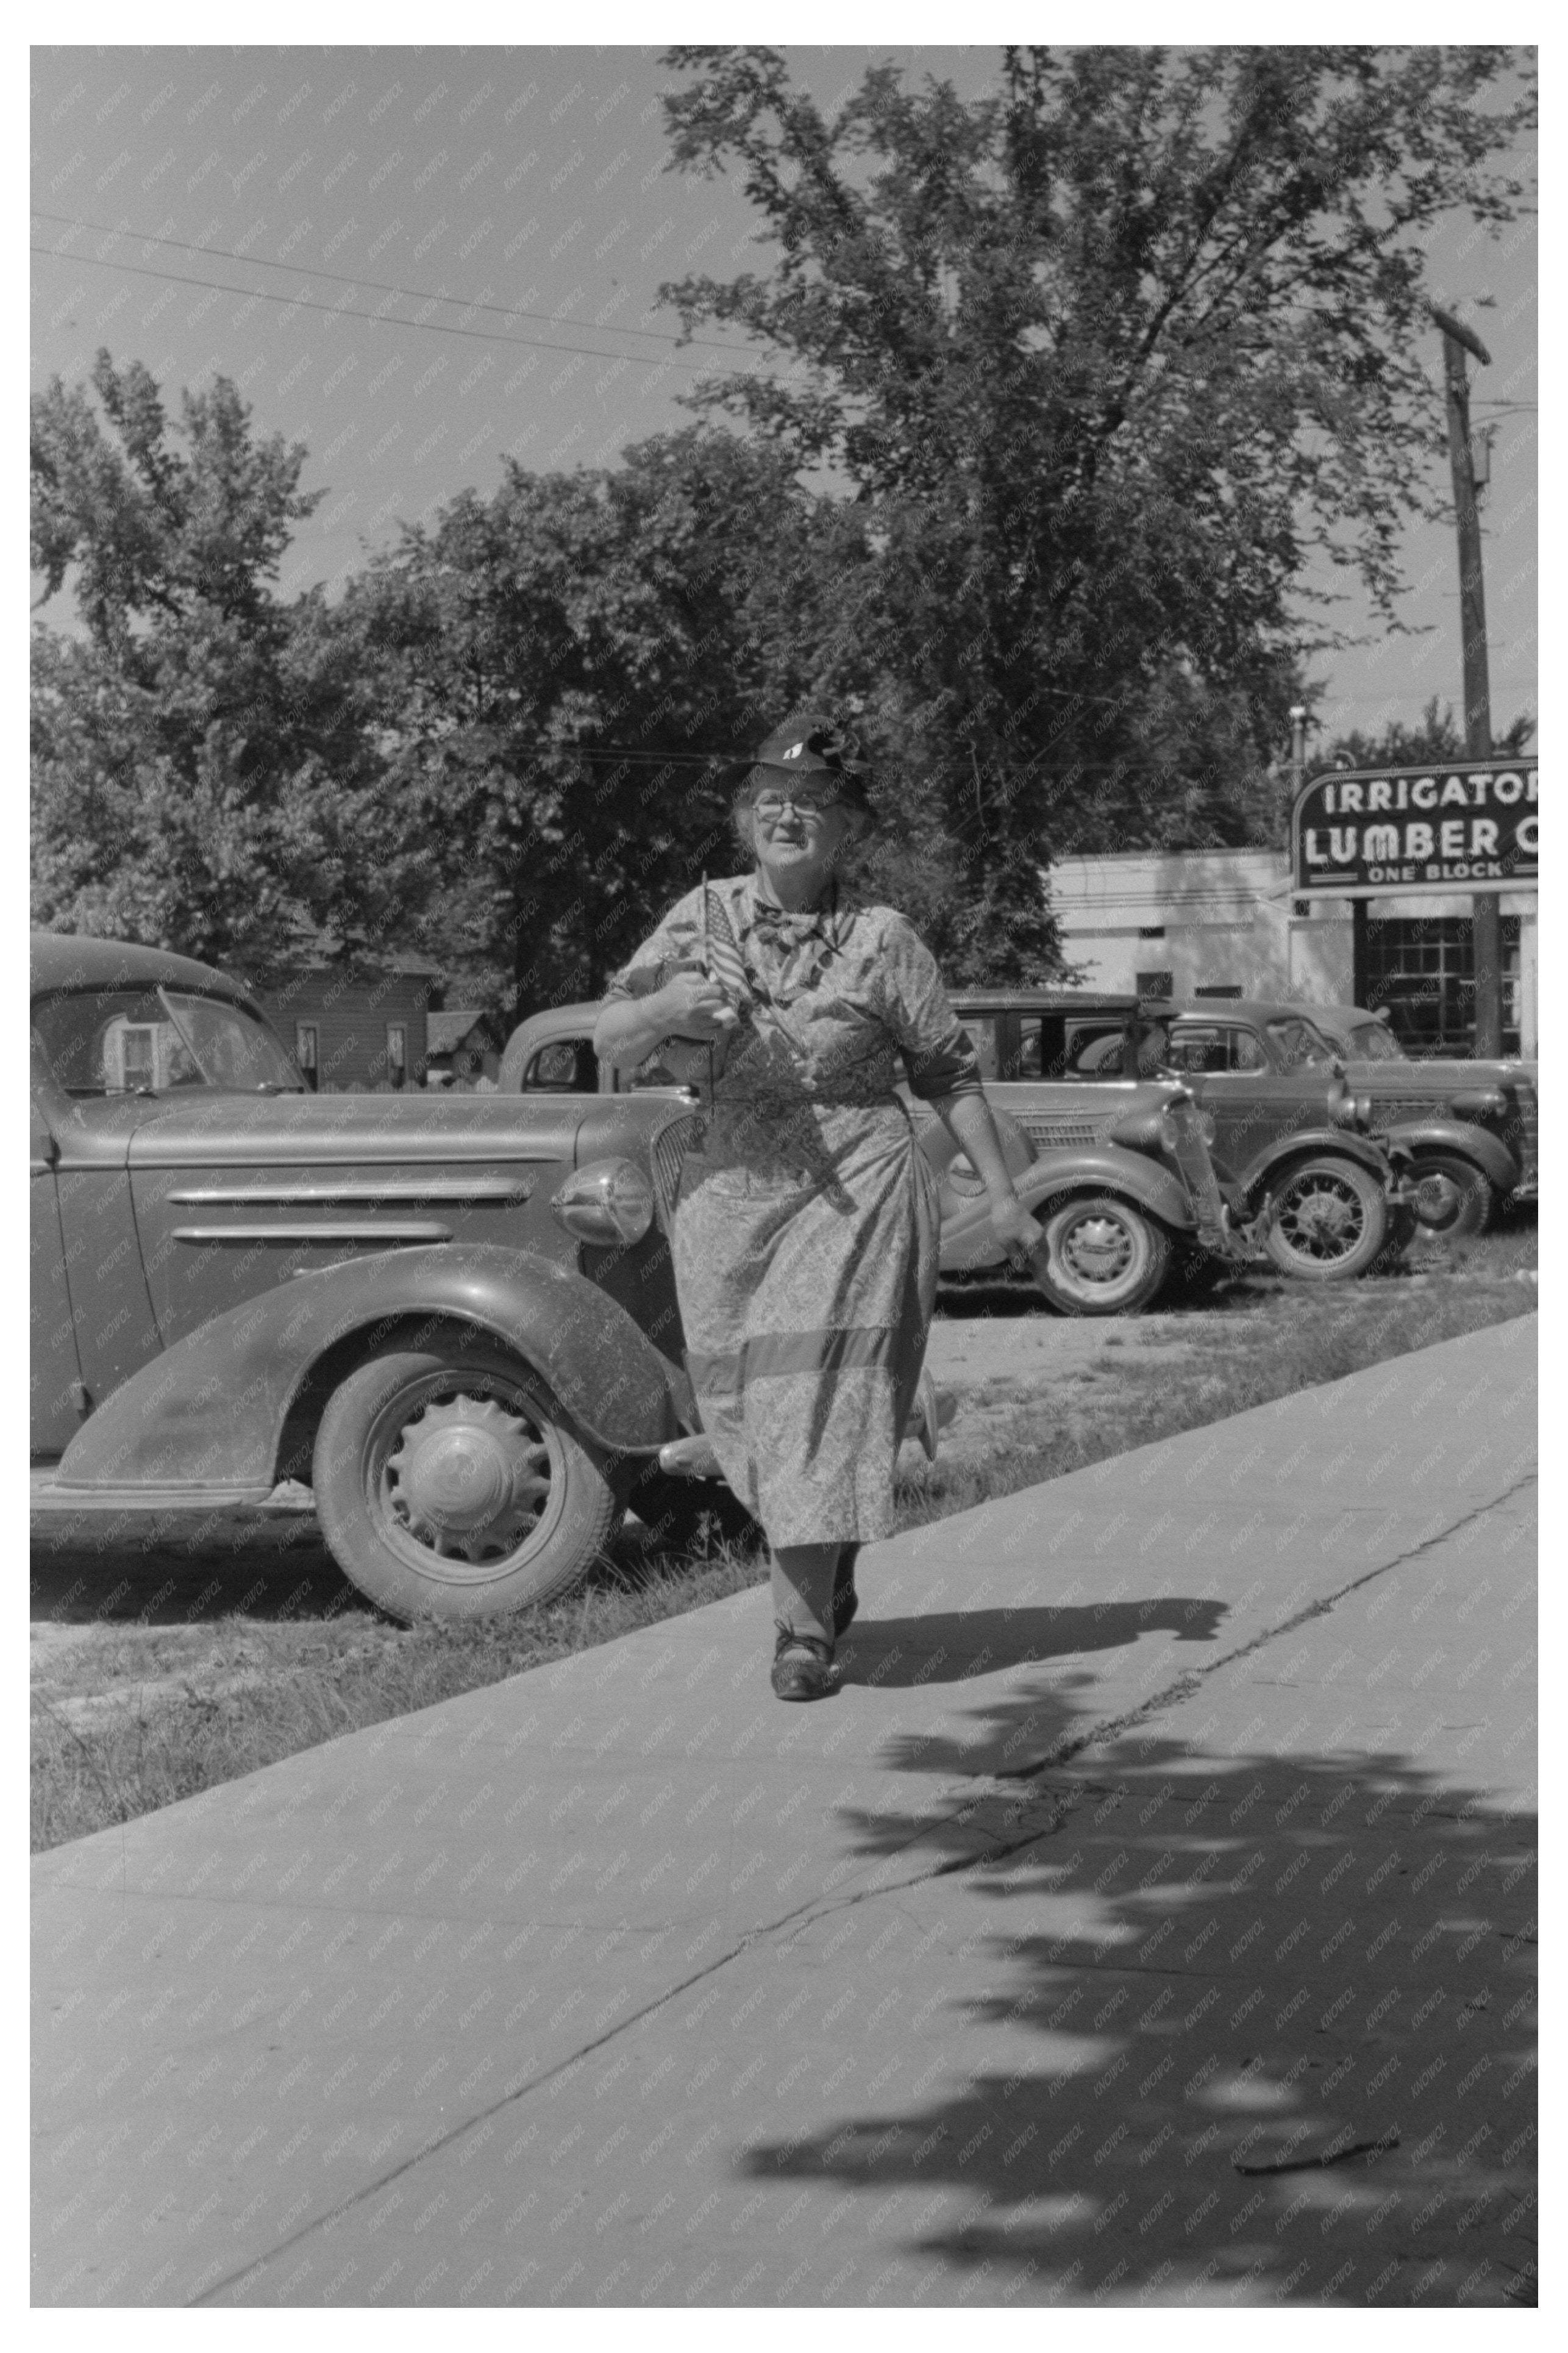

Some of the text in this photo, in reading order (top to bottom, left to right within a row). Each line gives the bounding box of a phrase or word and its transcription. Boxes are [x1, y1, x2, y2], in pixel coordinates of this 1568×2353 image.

[1305, 818, 1499, 865] LUMBER
[1368, 862, 1503, 883] ONE BLOCK
